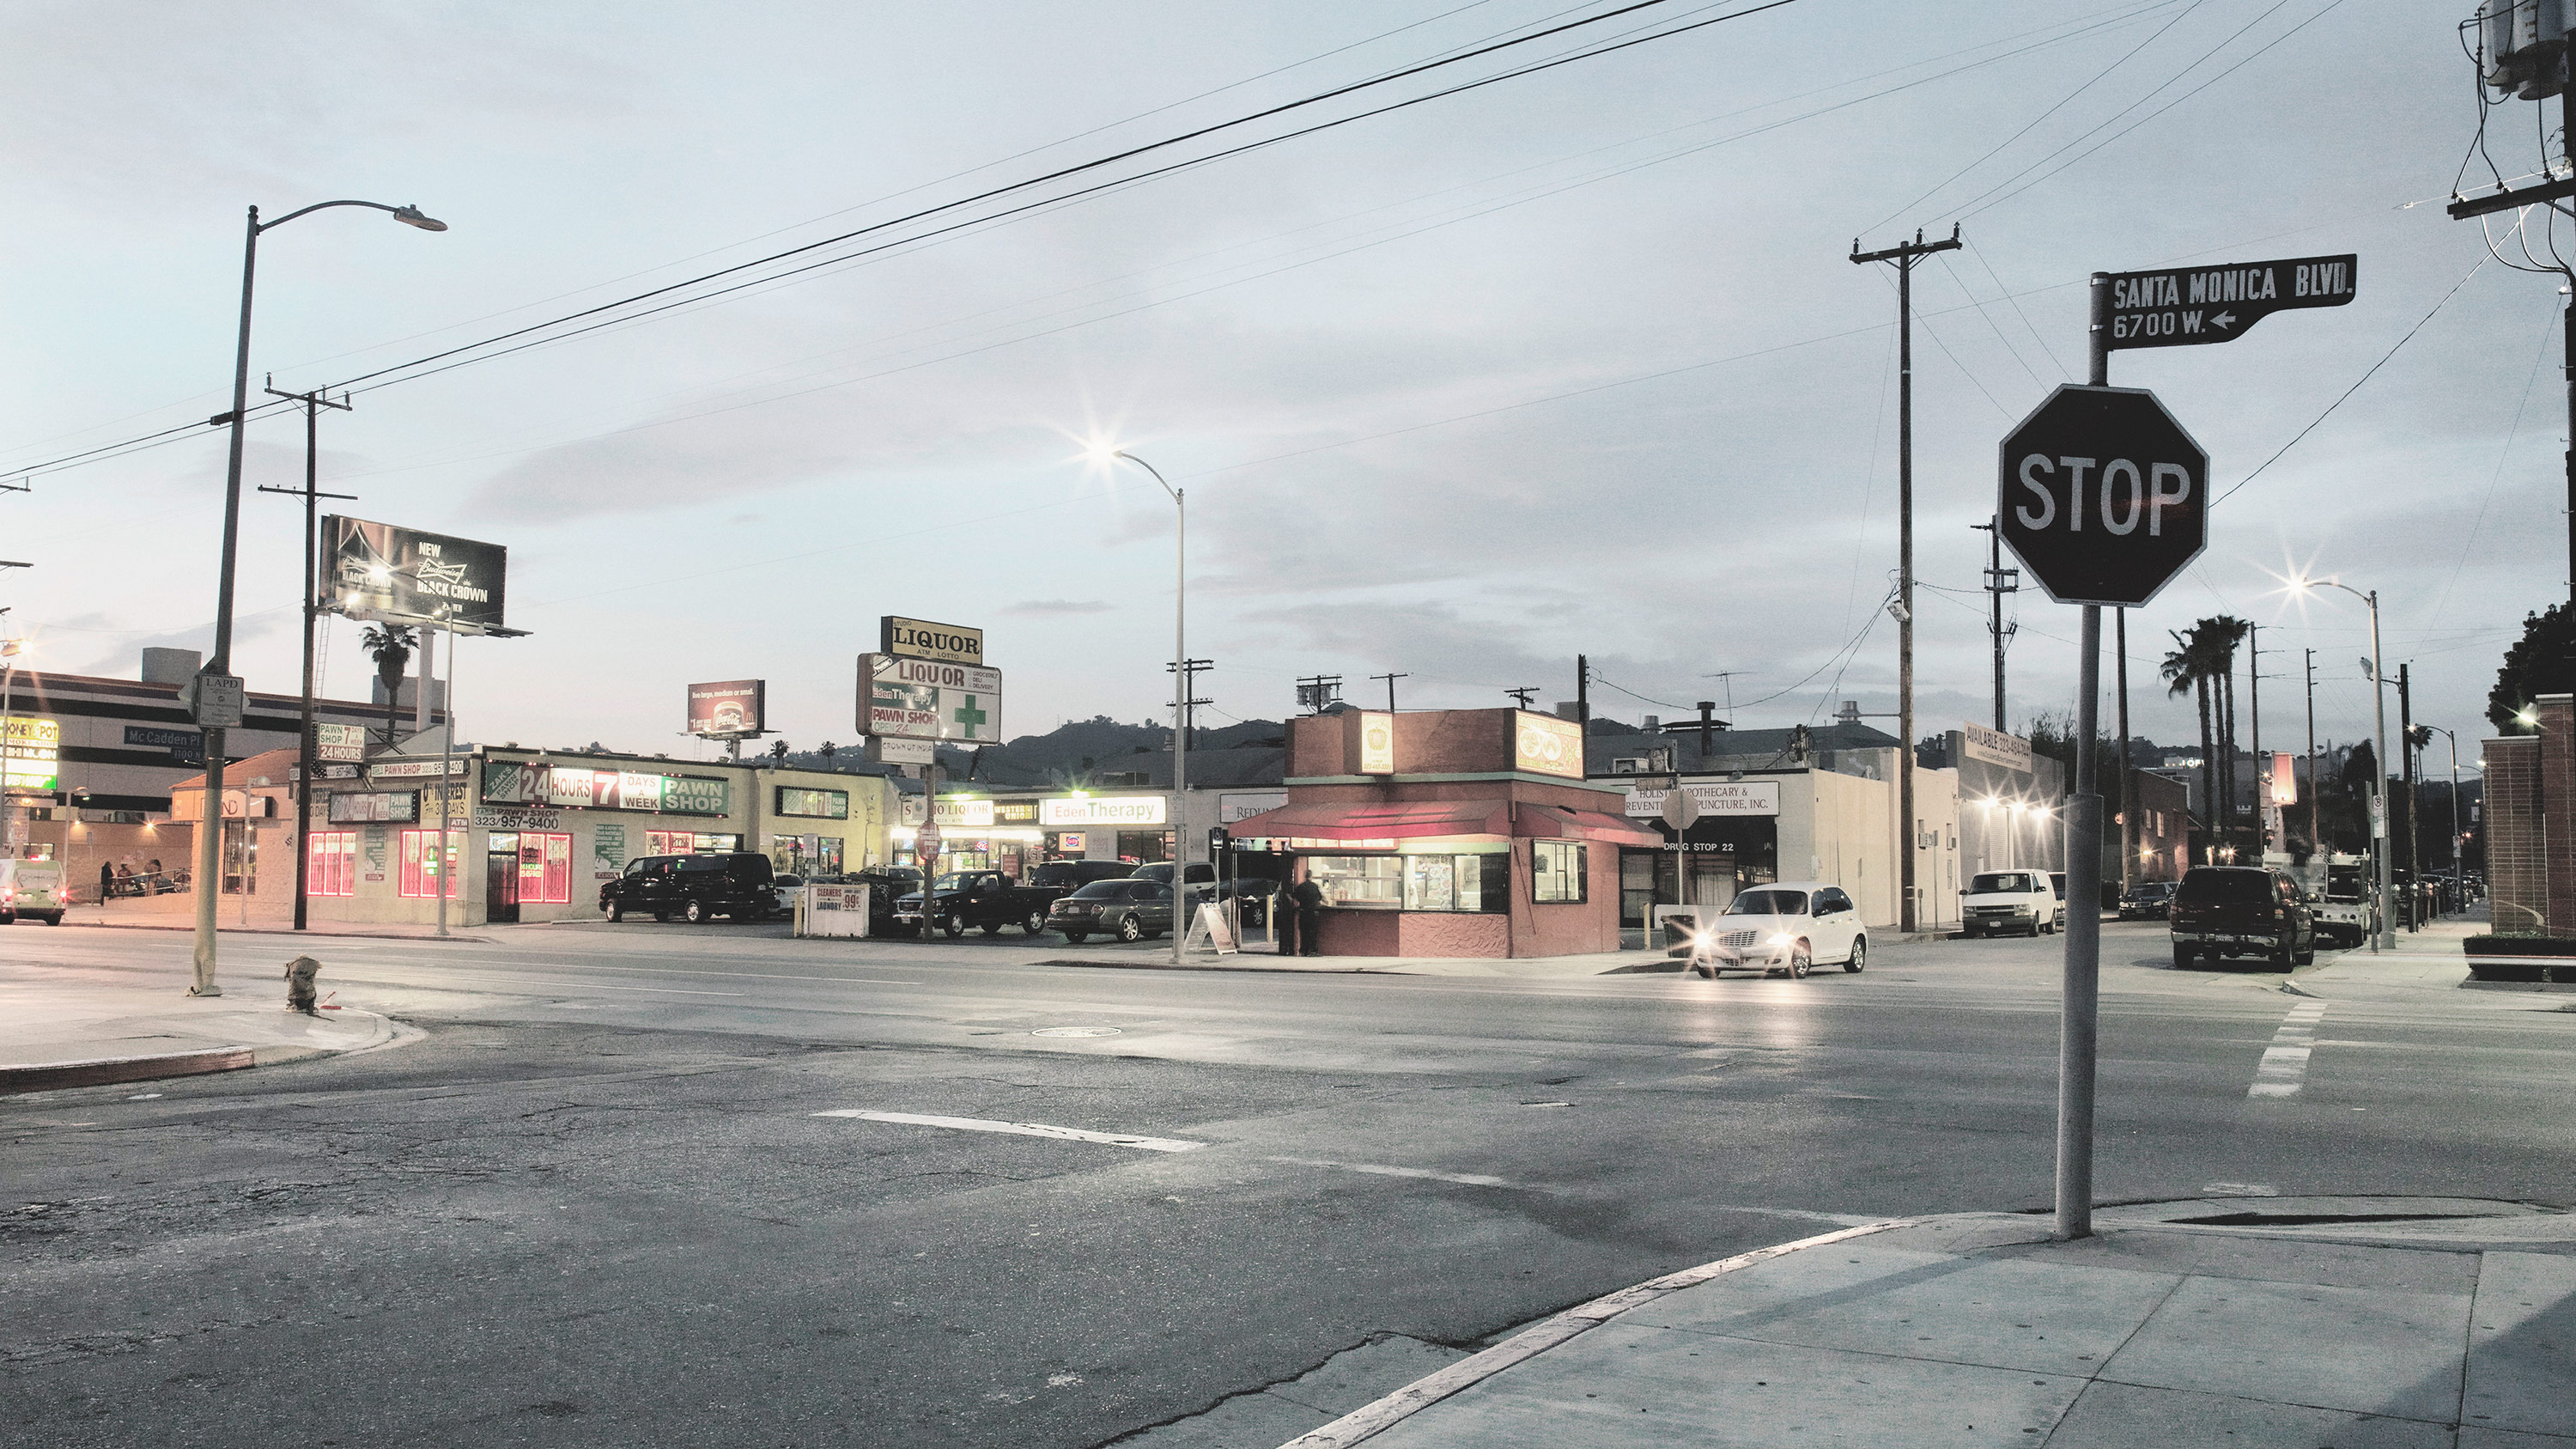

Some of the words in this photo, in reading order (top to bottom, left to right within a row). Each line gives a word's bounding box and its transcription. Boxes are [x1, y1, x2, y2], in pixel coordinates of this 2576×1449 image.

[2113, 274, 2180, 310] SANTA
[2189, 267, 2277, 305] MONICA
[2295, 261, 2354, 298] BLVD.
[2113, 311, 2175, 338] 6700
[2182, 310, 2206, 334] W.
[2014, 453, 2191, 537] STOP
[418, 541, 441, 557] NEW
[417, 560, 465, 581] Budweiser
[416, 580, 450, 597] BLACK
[451, 584, 489, 602] CROWN
[893, 627, 981, 655] LIQUOR
[899, 661, 965, 687] LIQUOR
[206, 678, 238, 689] LAPD
[872, 708, 905, 723] PAWN
[908, 713, 937, 726] SHOP
[6, 723, 33, 736] ONEY
[320, 725, 343, 734] PAWN
[896, 724, 909, 734] 24
[191, 735, 200, 746] Pl
[320, 734, 343, 744] SHOP
[343, 727, 351, 745] 7
[1966, 726, 1998, 750] AVAILABLE
[883, 741, 906, 752] CROWN
[174, 750, 192, 758] 1100
[385, 765, 403, 776] PAWN
[404, 764, 421, 774] SHOP
[4, 774, 52, 788] UBWAY
[489, 766, 513, 790] ZAK'S
[495, 774, 517, 795] PAWN
[628, 776, 656, 788] DAYS
[434, 782, 467, 801] INREST
[500, 779, 519, 800] SHOP
[521, 769, 550, 802] 24
[551, 776, 592, 798] HOURS
[594, 774, 618, 805] 7
[665, 779, 723, 796] PAWN
[1681, 788, 1739, 798] POTHECARY
[1741, 787, 1748, 796] &
[390, 795, 411, 805] PAWN
[625, 797, 659, 808] WEEK
[665, 795, 722, 811] SHOP
[818, 795, 824, 812] 7
[832, 797, 846, 806] PAWN
[1750, 799, 1769, 809] INC.
[368, 796, 376, 819] 7
[390, 807, 411, 818] SHOP
[496, 808, 527, 817] PAWN
[530, 809, 560, 818] SHOP
[831, 805, 846, 813] SHOP
[475, 816, 559, 830] 323/957-9400
[1663, 843, 1689, 851] DRUG
[1693, 843, 1717, 851] STOP
[1722, 843, 1735, 851] 22
[1024, 849, 1044, 859] ICE
[817, 888, 842, 898] CLEANERS
[817, 902, 841, 910] LAUNDRY
